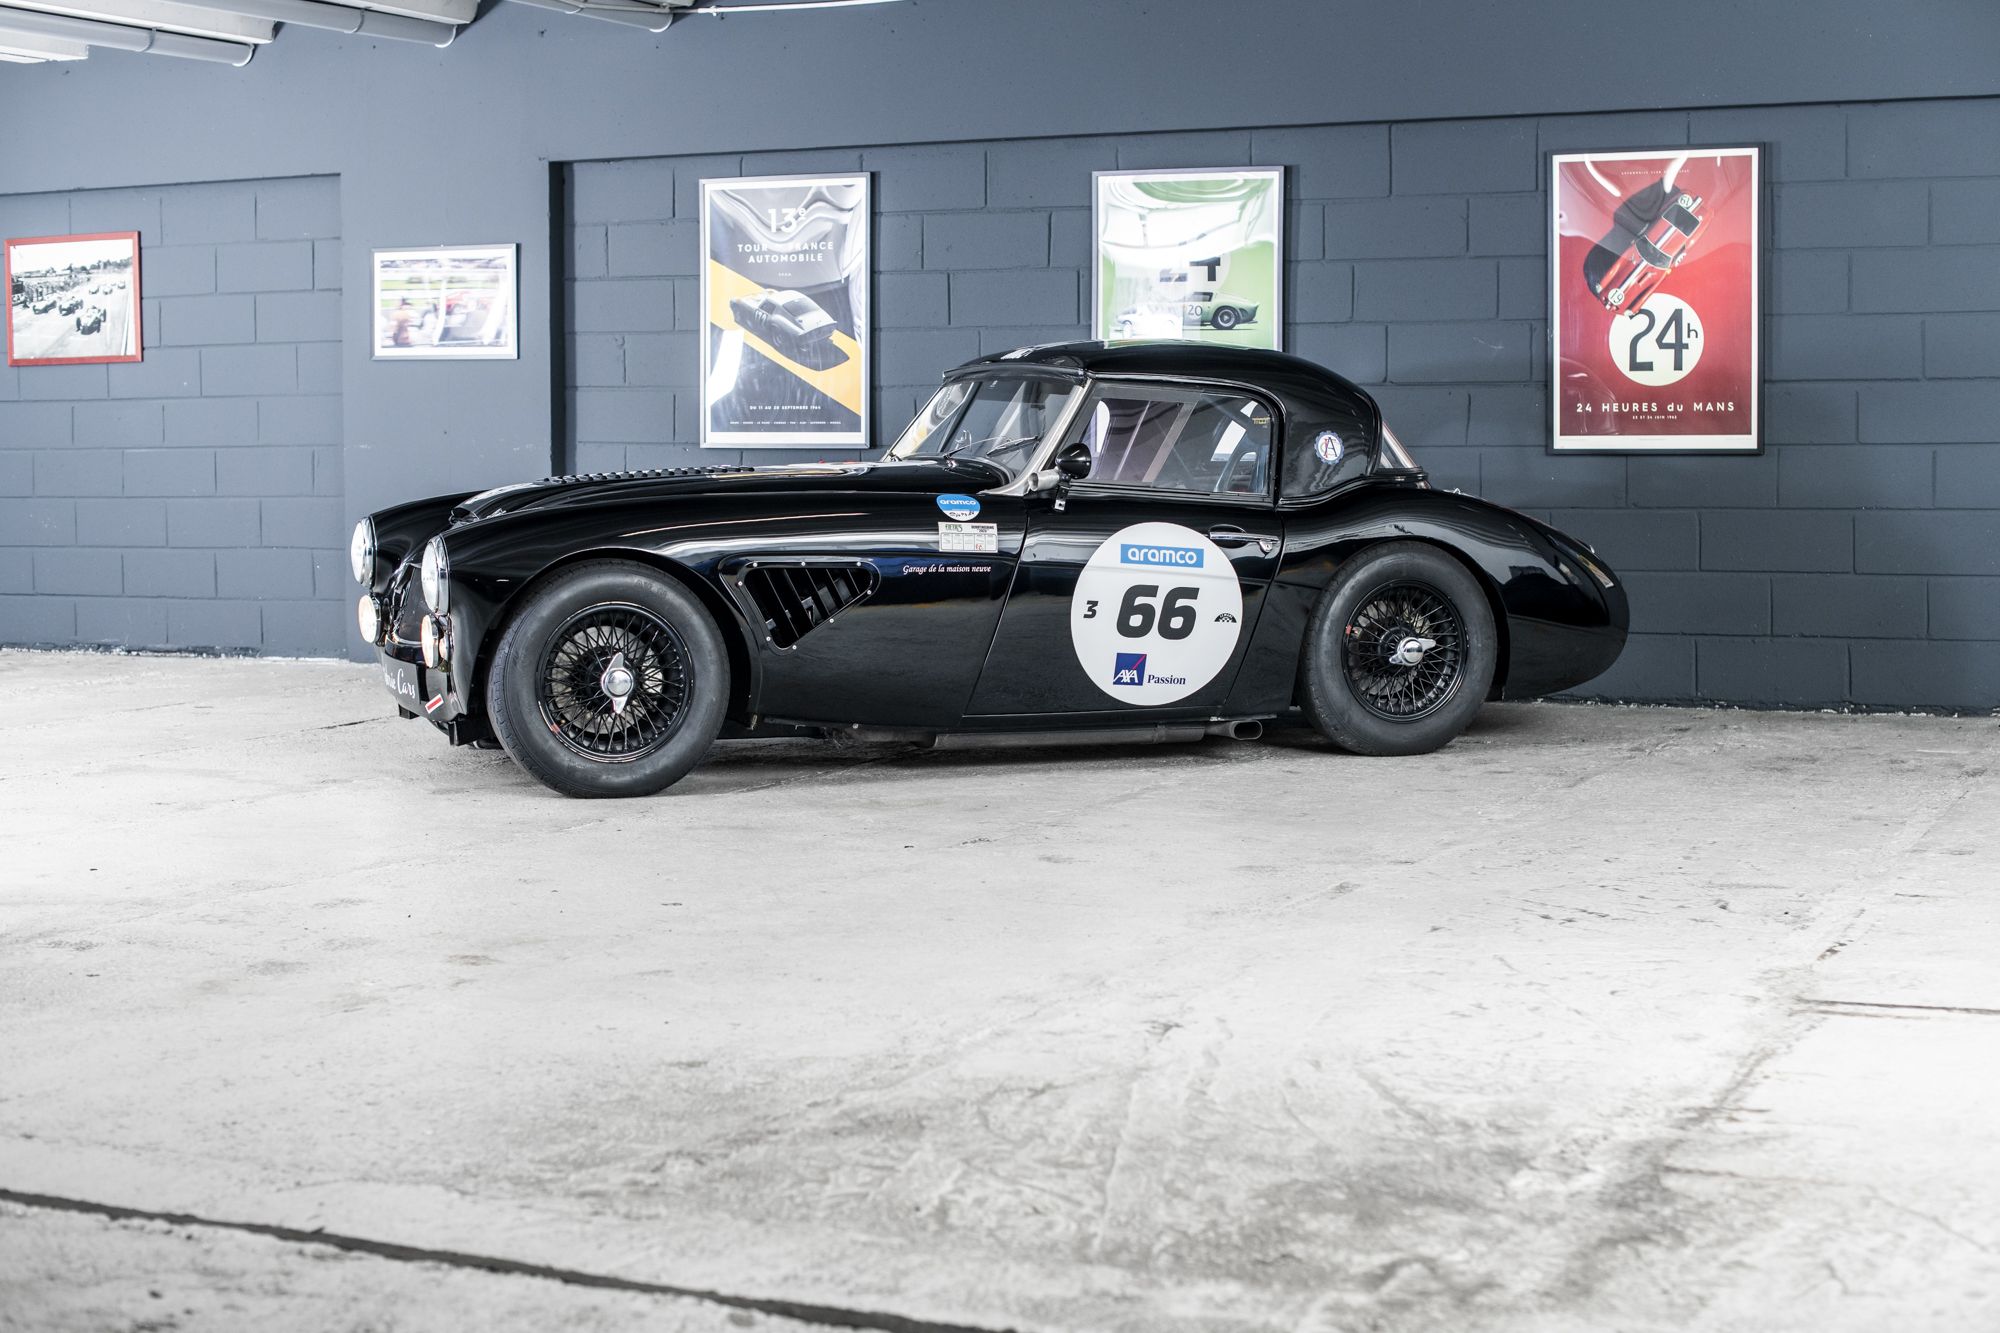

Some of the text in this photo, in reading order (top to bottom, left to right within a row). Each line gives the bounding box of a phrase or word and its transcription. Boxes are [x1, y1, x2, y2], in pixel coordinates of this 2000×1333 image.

[737, 241, 834, 253] TOUR RANCE
[748, 253, 823, 263] AUTOMOBILE
[1188, 305, 1203, 317] 20
[1576, 402, 1735, 412] 24 HEURES du MANS
[1127, 547, 1197, 565] aramco
[902, 564, 927, 575] Garage
[928, 563, 937, 573] de
[938, 563, 945, 573] la
[946, 564, 970, 573] maison
[1083, 584, 1200, 640] 3 66
[1113, 669, 1186, 685] AXA Passion
[397, 668, 416, 699] Cars
